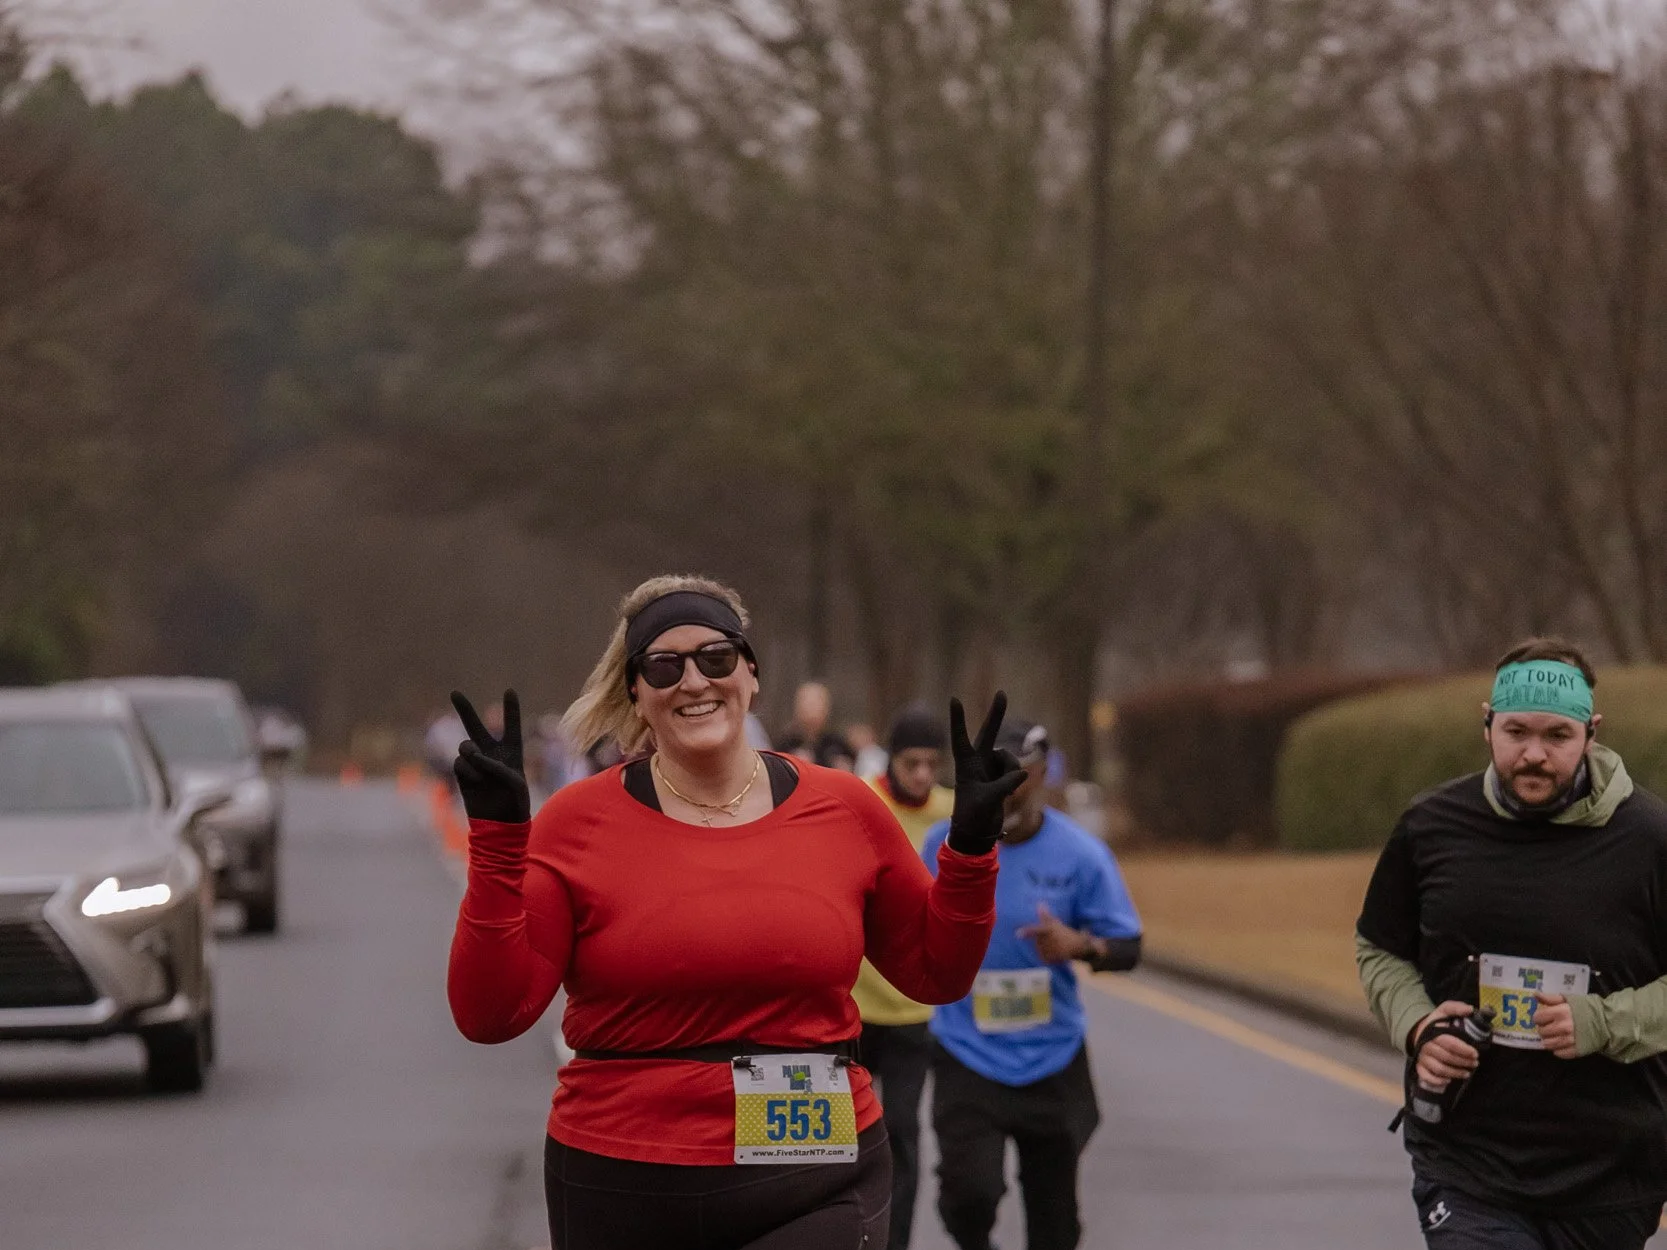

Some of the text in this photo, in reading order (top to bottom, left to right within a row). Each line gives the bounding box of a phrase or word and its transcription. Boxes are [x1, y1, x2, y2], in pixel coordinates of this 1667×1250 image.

[1499, 669, 1576, 691] NOT TODAY
[1502, 993, 1538, 1030] 53
[766, 1098, 832, 1142] 553
[752, 1148, 845, 1157] www.FiveStarNTP.com
